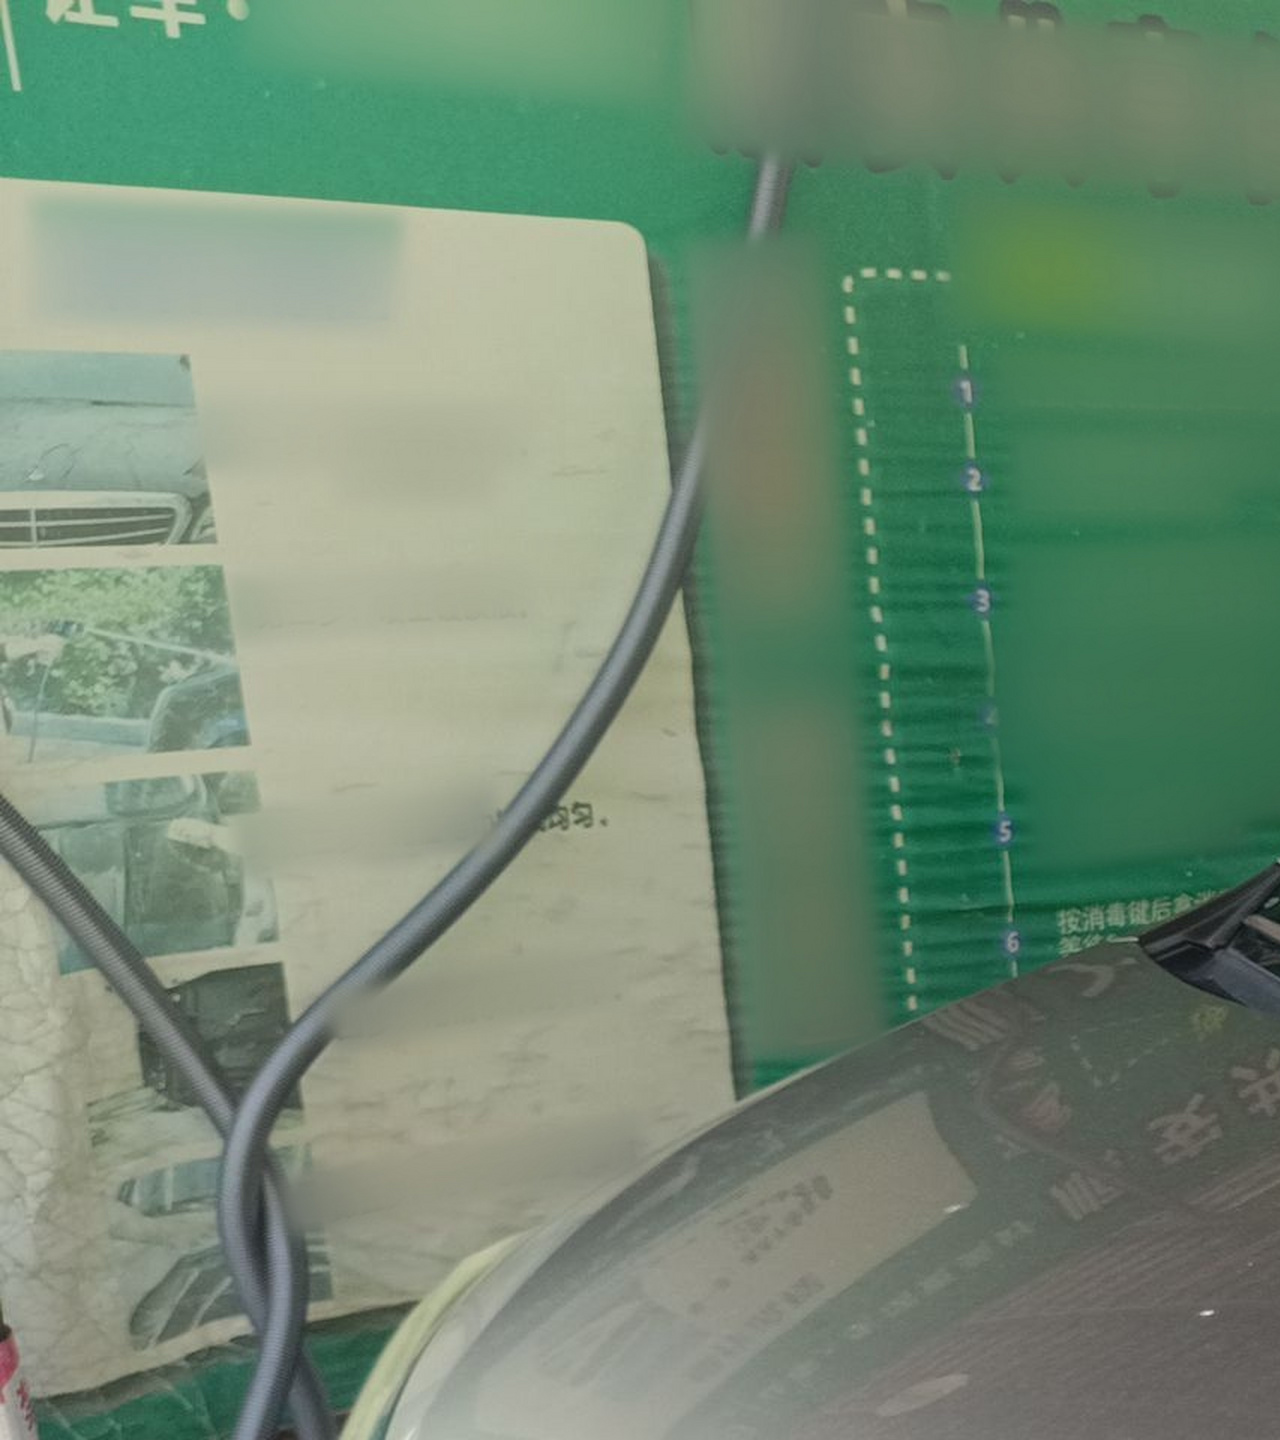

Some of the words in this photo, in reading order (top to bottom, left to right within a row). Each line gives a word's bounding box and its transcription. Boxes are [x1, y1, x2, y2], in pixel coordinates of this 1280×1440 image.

[959, 379, 973, 404] 1
[967, 467, 982, 491] 2
[975, 589, 989, 613] 3
[999, 820, 1012, 843] 5
[1057, 889, 1226, 935] 按消毒键后拿
[1007, 930, 1020, 954] 6
